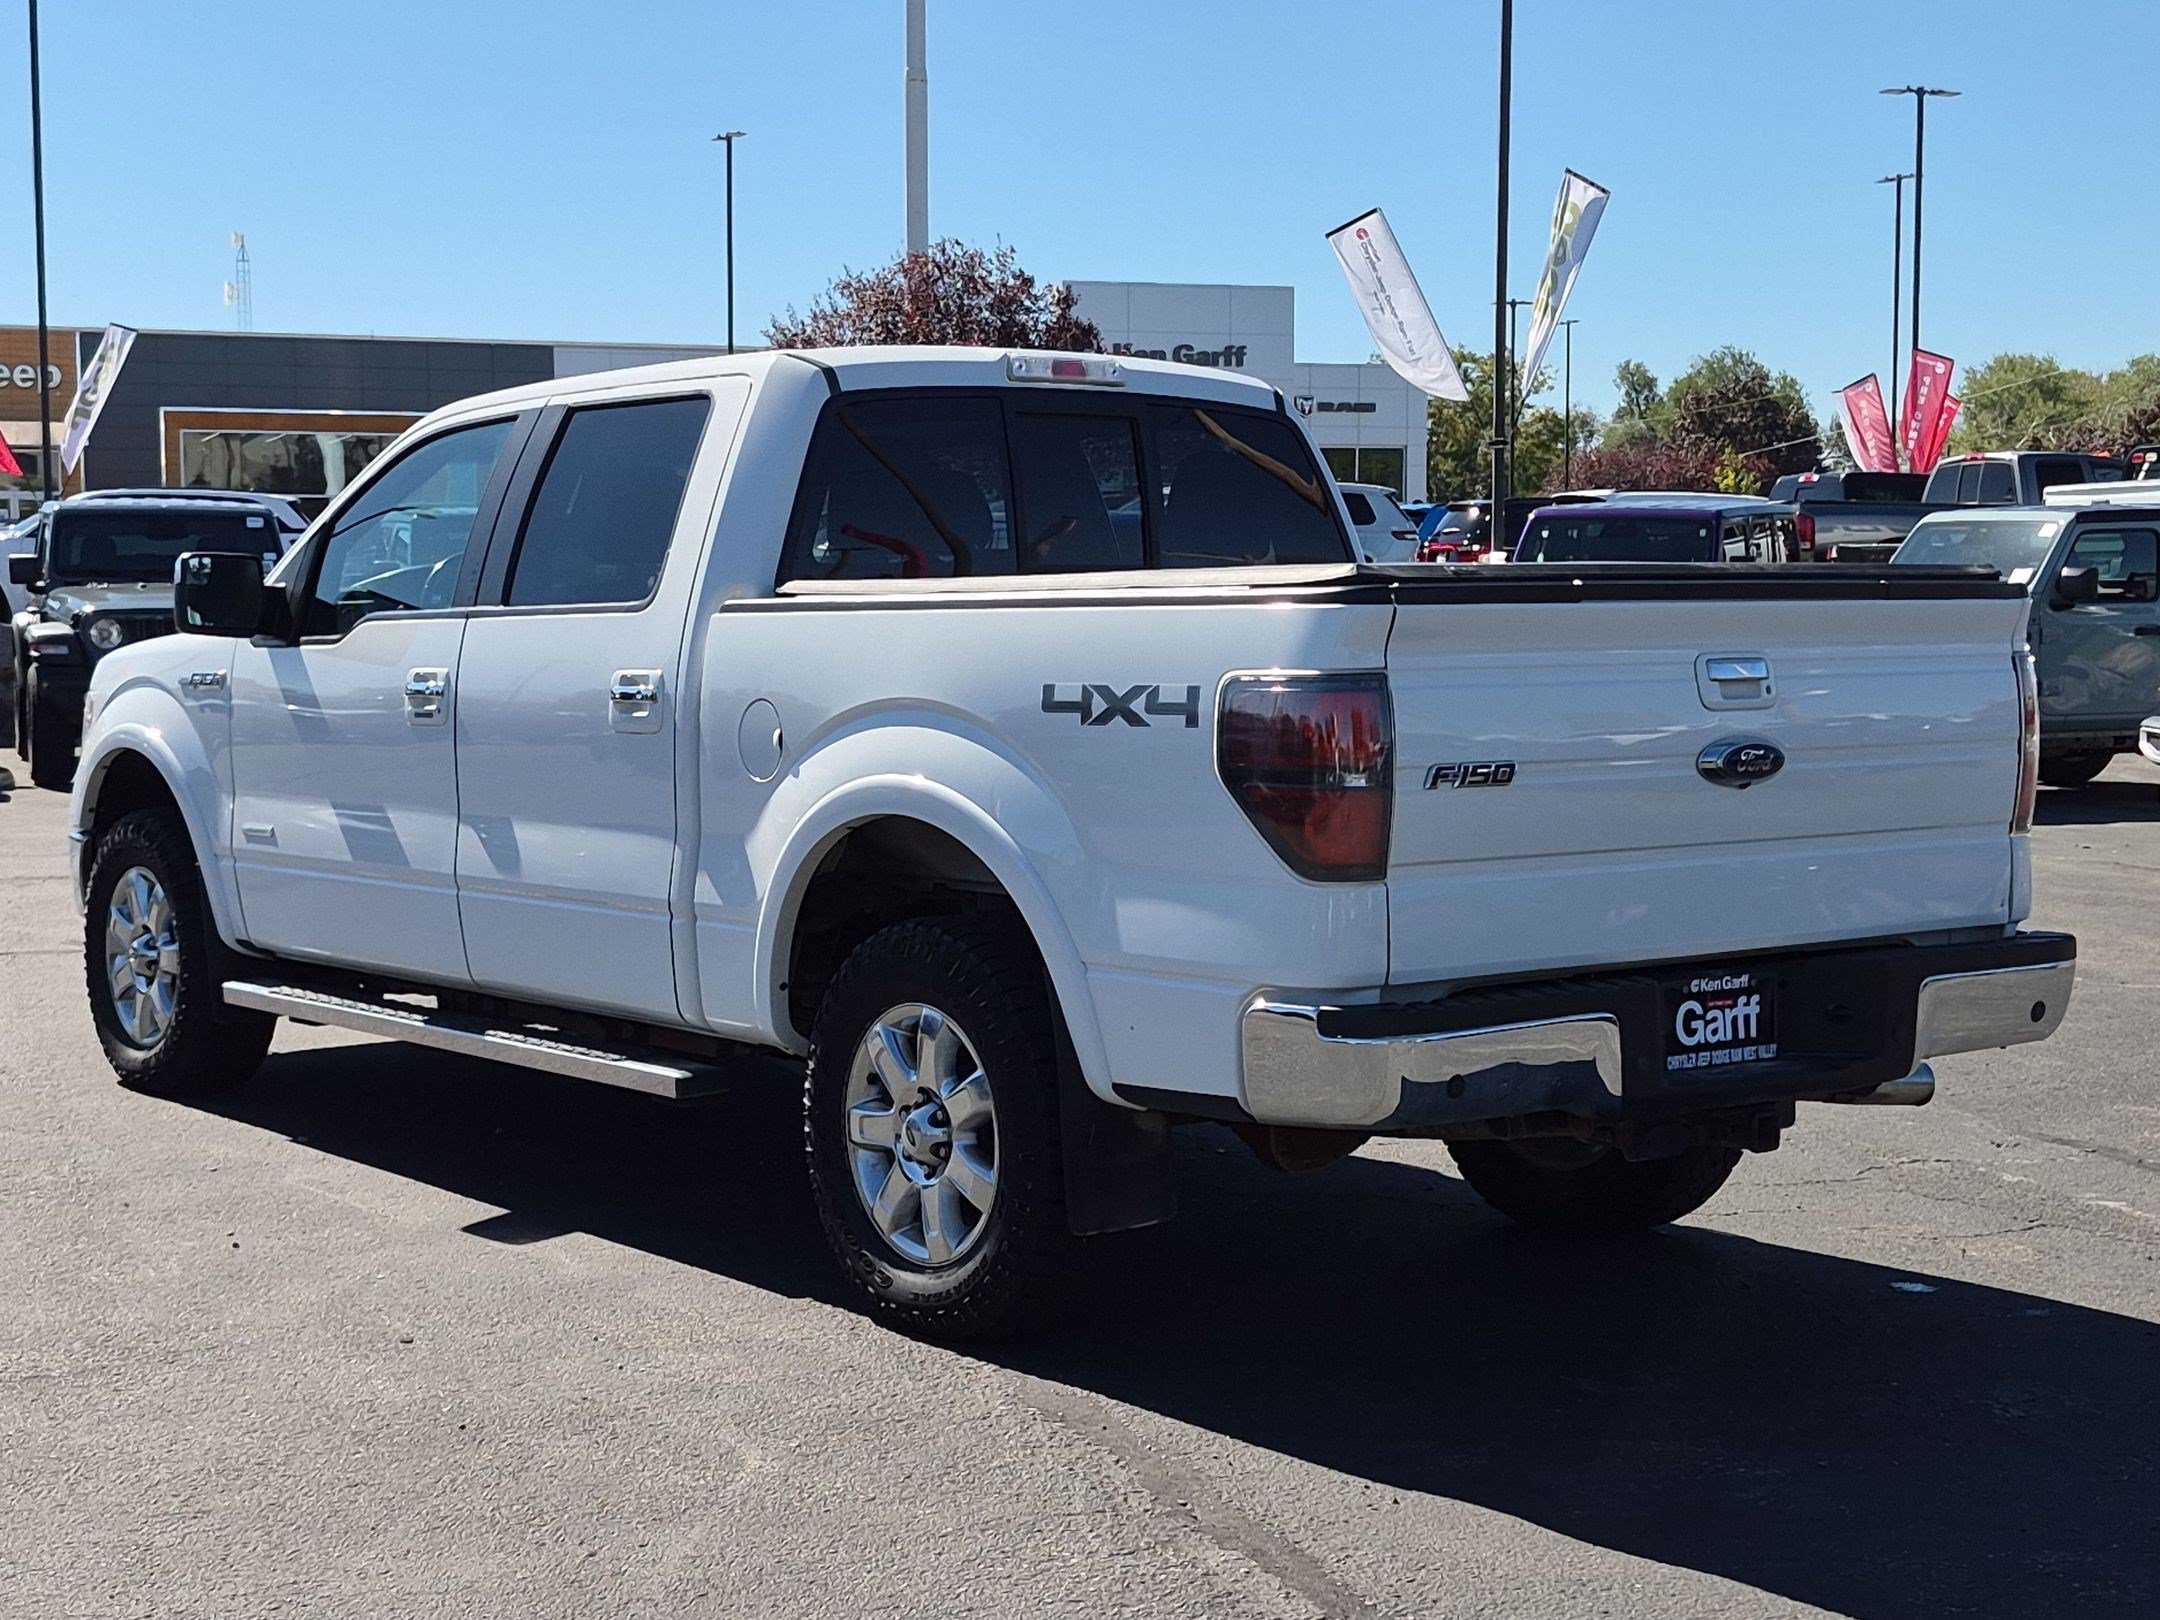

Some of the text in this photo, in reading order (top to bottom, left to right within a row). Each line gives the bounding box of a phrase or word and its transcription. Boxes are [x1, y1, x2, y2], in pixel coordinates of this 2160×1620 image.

[1172, 343, 1248, 367] Garff
[1737, 749, 1775, 772] Ford
[1700, 974, 1750, 992] Ken Garff
[1675, 994, 1760, 1046] Garff
